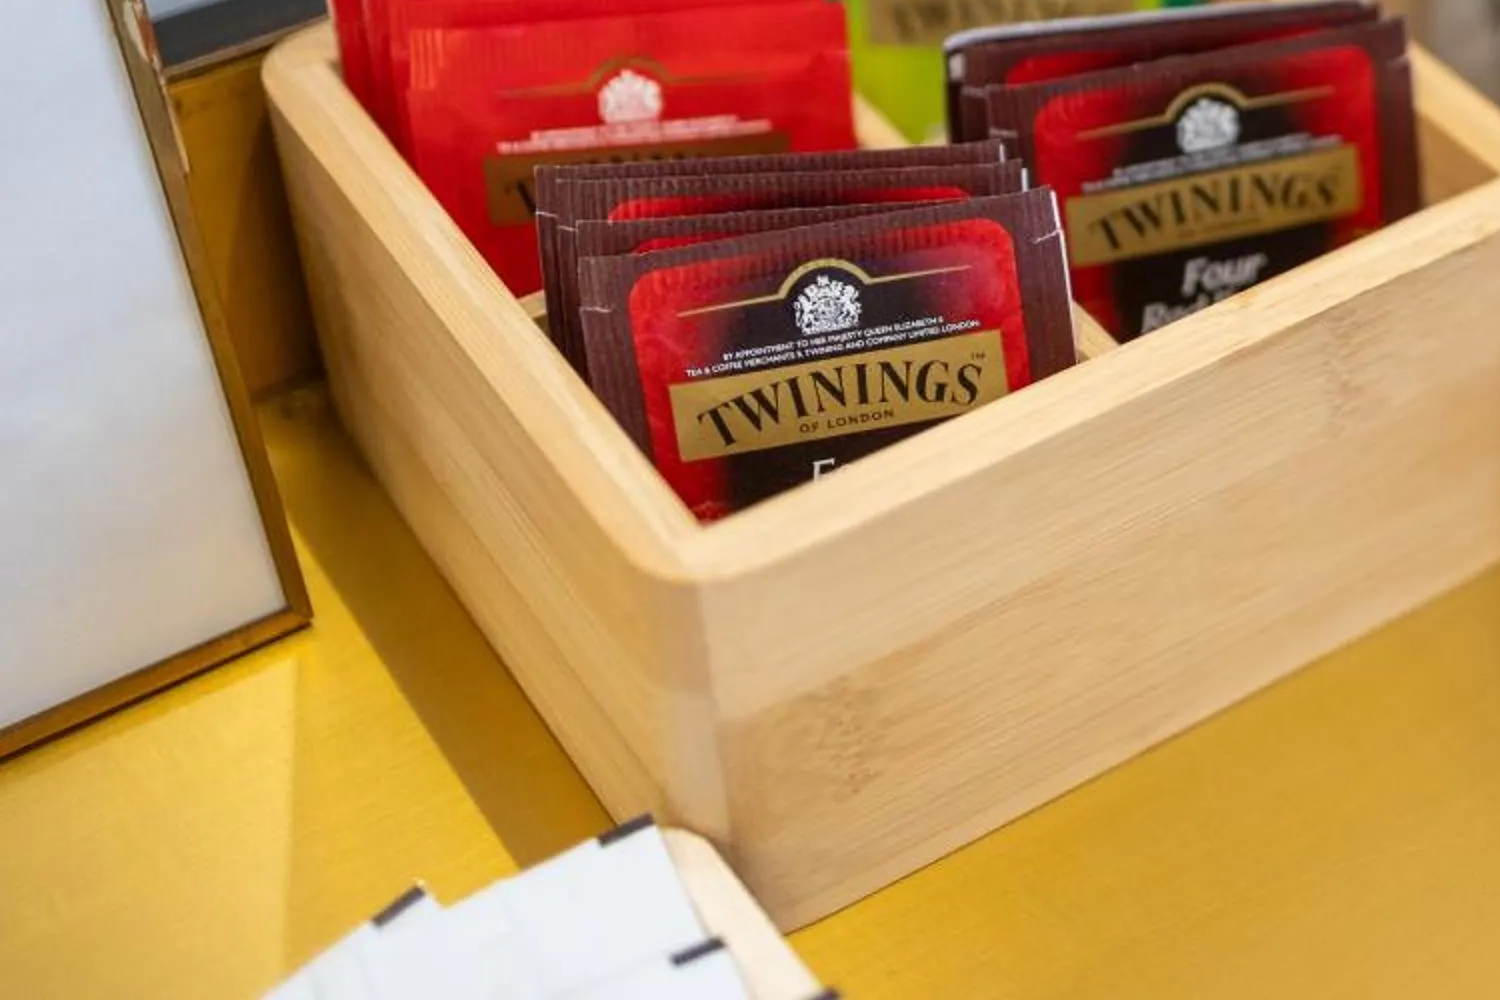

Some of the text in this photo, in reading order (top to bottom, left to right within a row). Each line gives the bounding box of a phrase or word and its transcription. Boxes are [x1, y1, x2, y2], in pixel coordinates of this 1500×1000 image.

[1087, 170, 1342, 250] TWININGS
[1182, 254, 1267, 297] Four
[686, 367, 703, 377] TEA
[712, 360, 743, 373] COFFEE
[697, 359, 982, 447] TWININGS
[799, 408, 895, 434] OF LONDON
